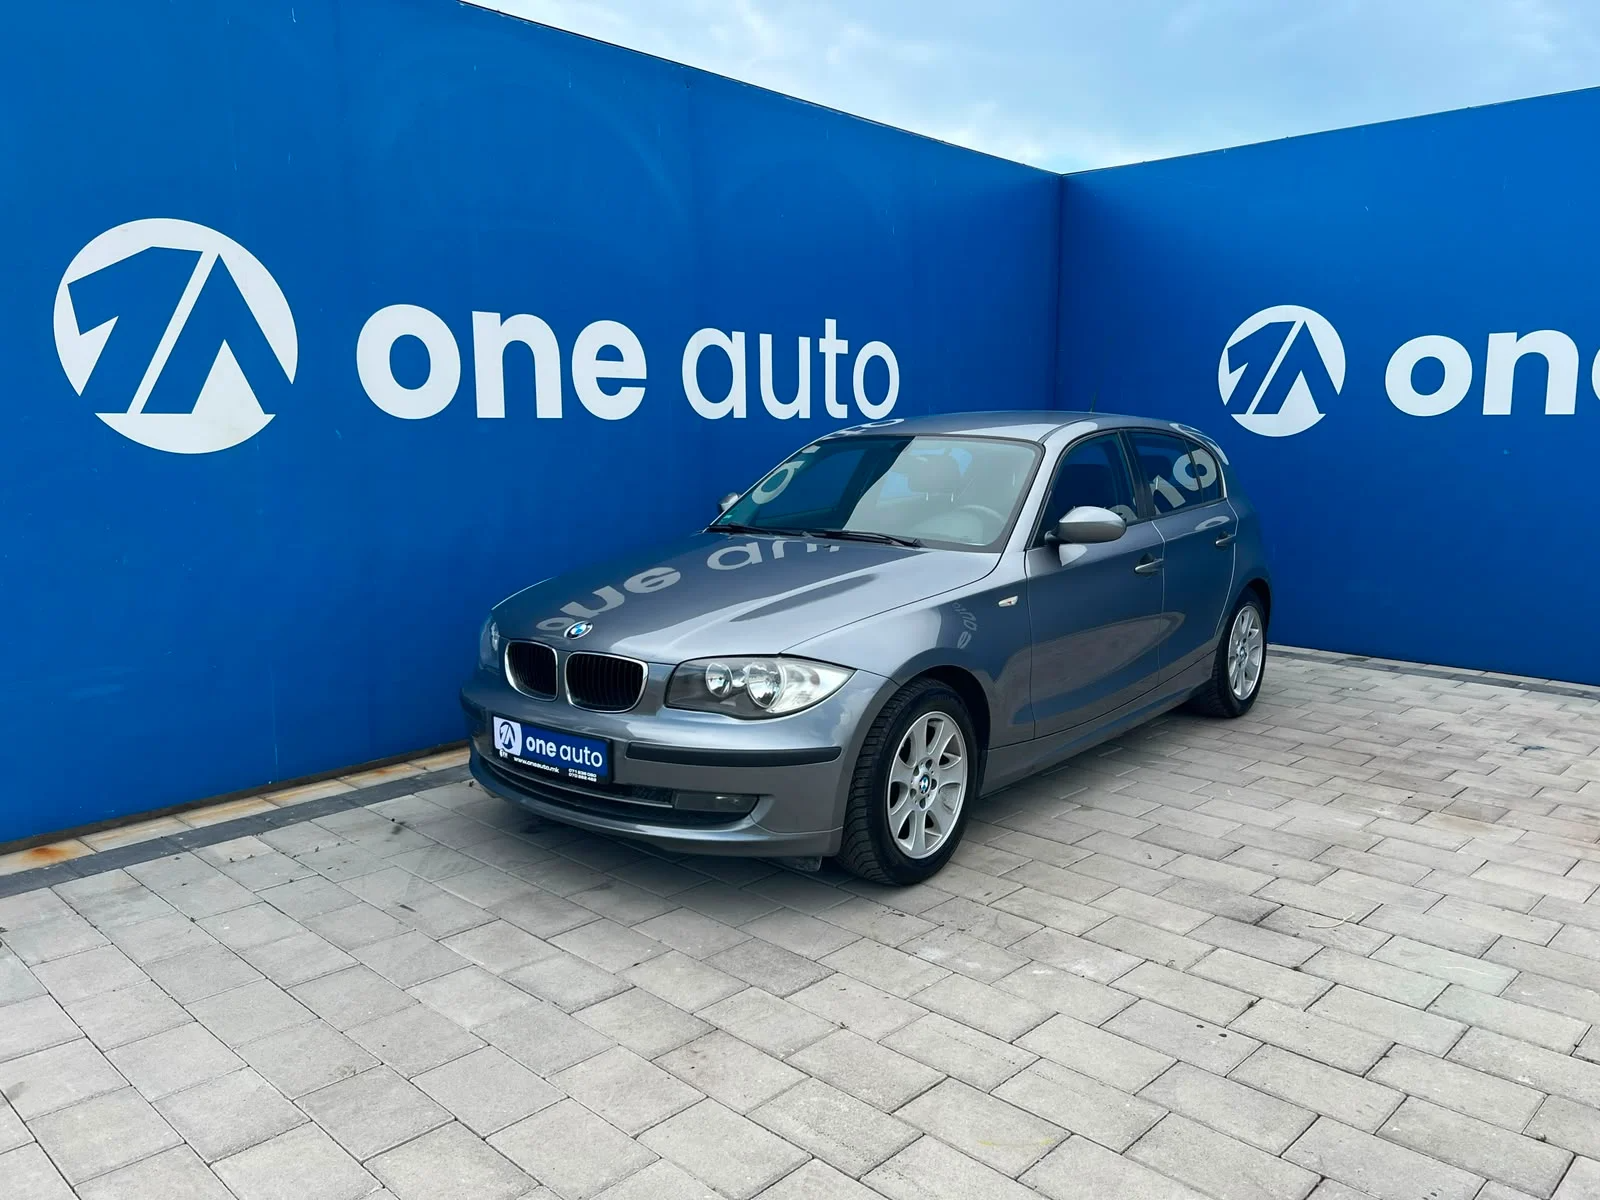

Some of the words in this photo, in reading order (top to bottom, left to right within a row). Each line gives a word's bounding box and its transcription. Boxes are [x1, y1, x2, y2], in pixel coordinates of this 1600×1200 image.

[357, 304, 646, 420] one
[682, 318, 899, 420] auto
[1385, 329, 1600, 417] on
[513, 756, 560, 774] www.oneauto.mk
[526, 736, 557, 757] one
[560, 745, 603, 768] auto
